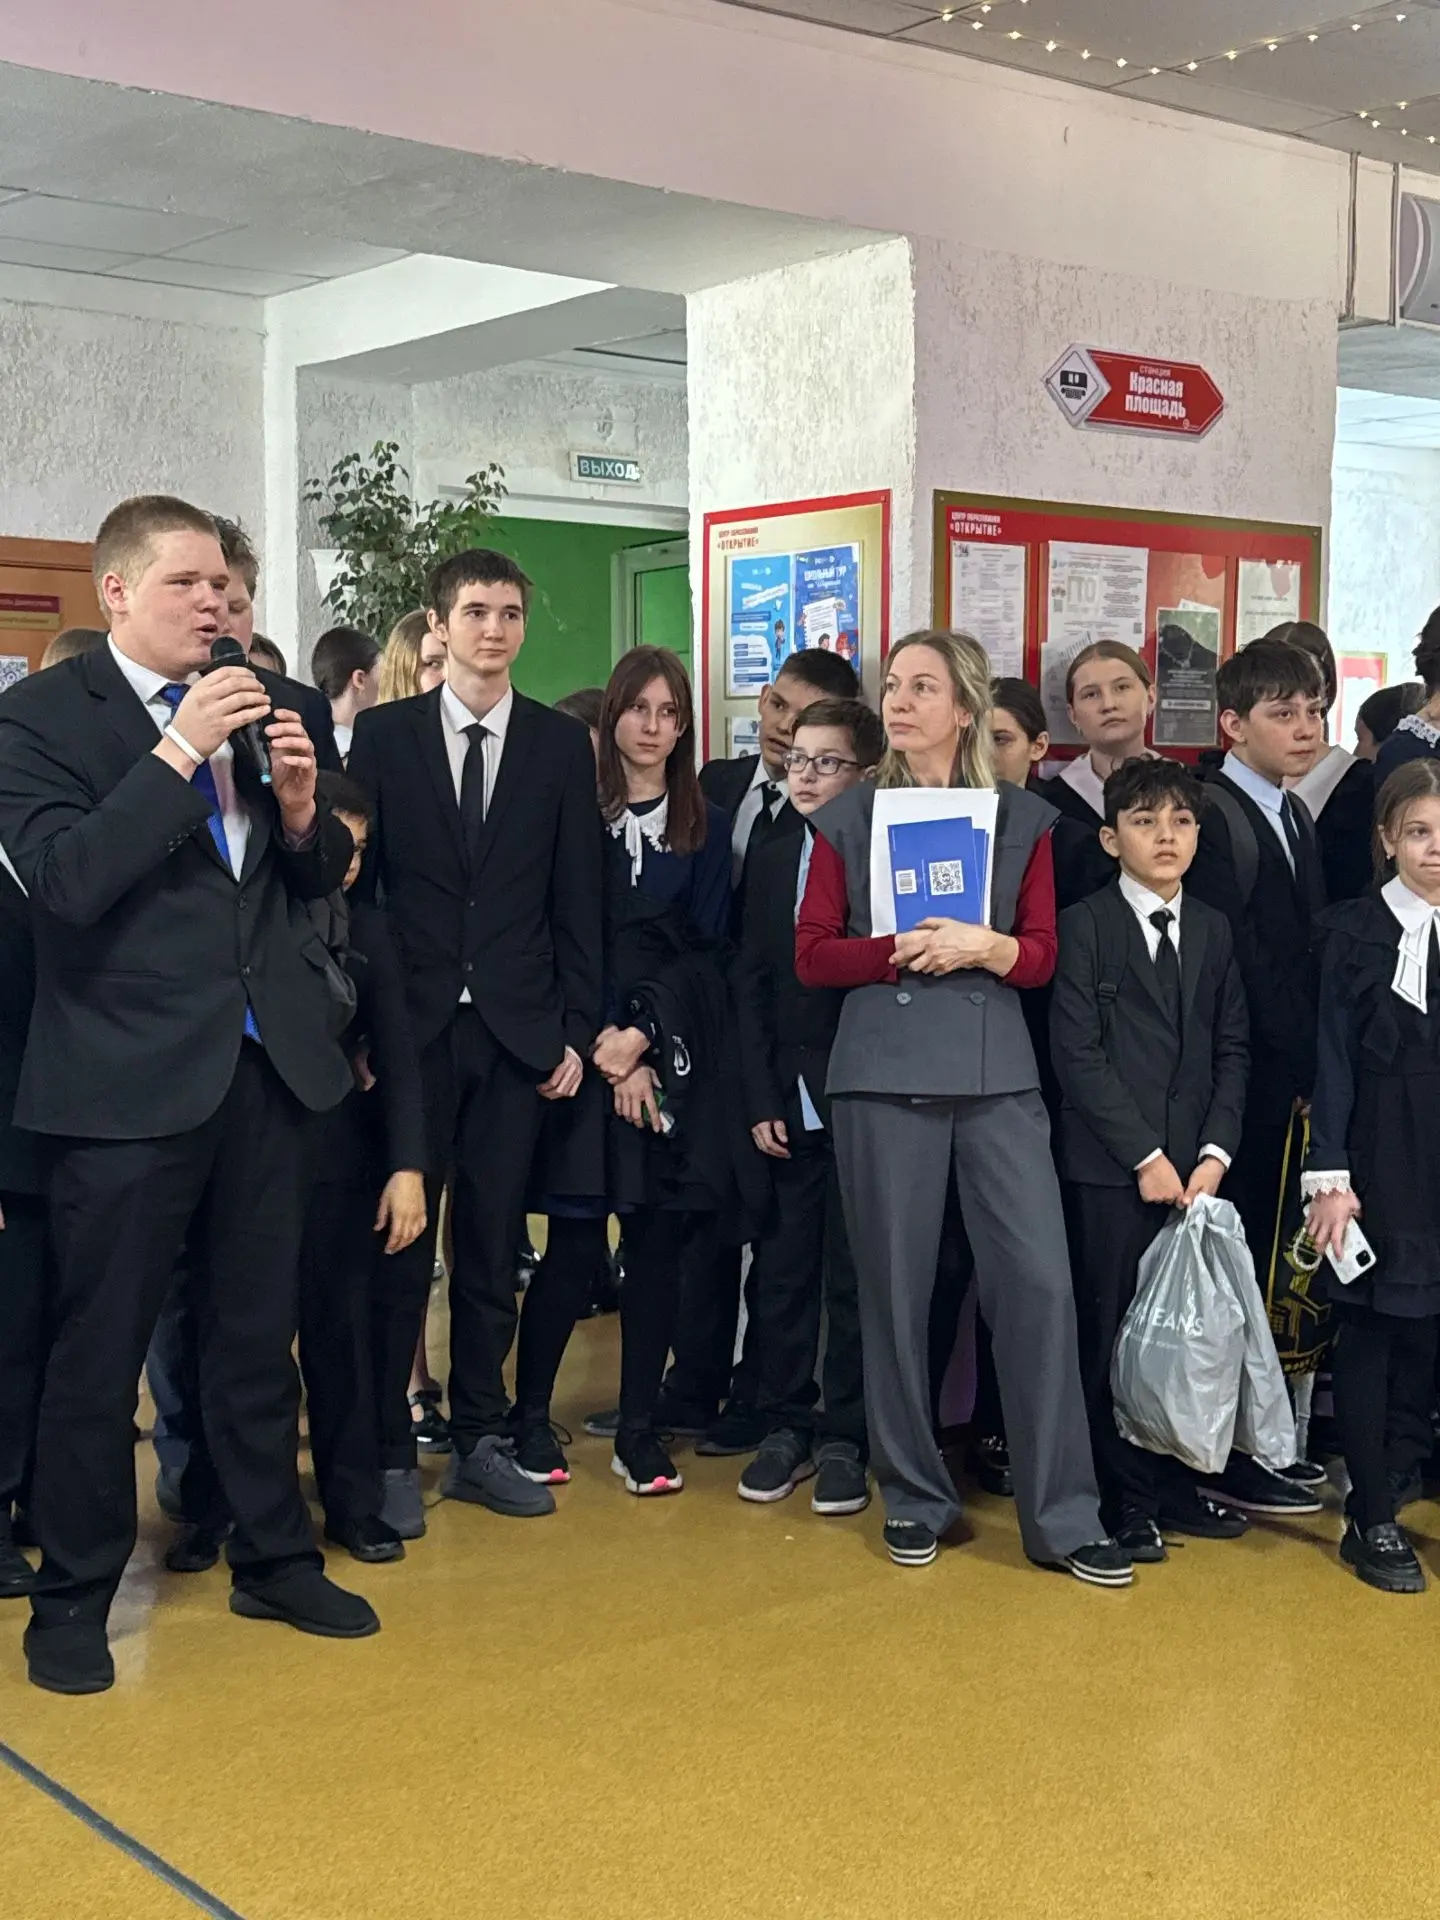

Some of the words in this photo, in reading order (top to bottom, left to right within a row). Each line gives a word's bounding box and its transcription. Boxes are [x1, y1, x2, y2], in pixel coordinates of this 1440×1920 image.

[1129, 371, 1184, 398] Красная
[1125, 394, 1187, 420] площадь
[580, 459, 640, 480] ВЫХОД
